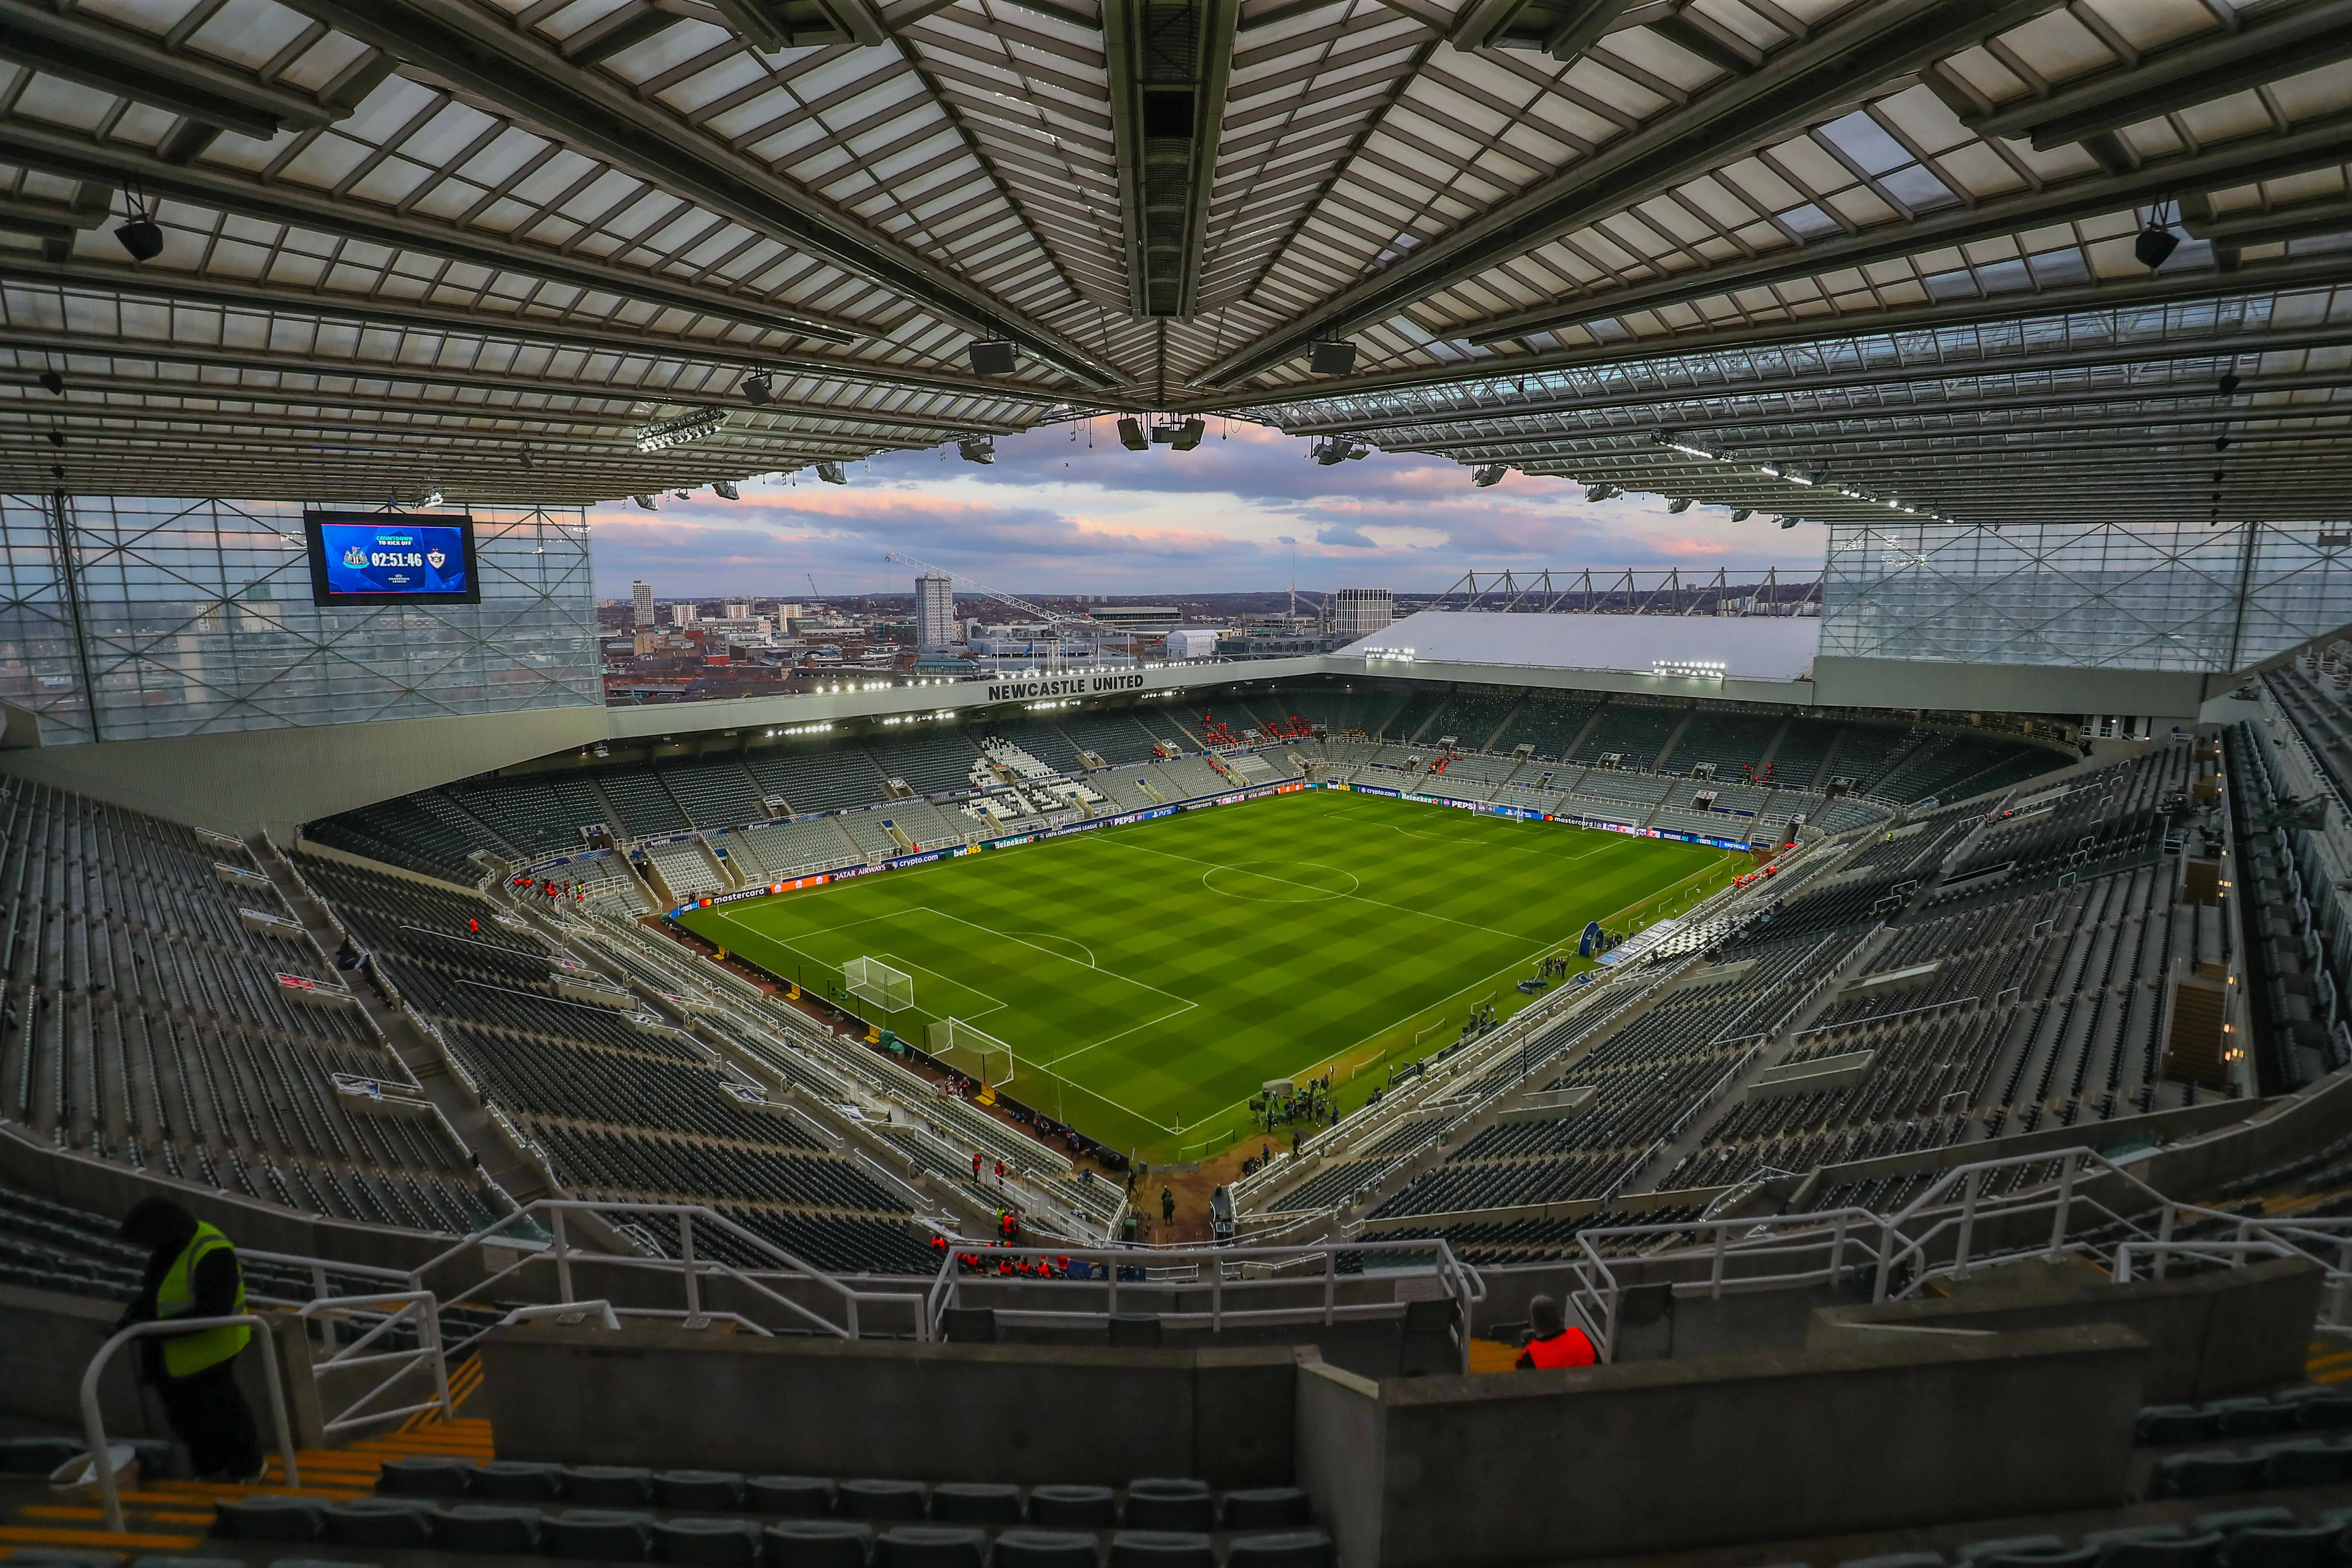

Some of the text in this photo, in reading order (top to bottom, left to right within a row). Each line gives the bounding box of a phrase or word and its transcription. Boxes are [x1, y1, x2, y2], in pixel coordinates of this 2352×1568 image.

[371, 552, 423, 567] 02:51:46
[989, 674, 1144, 701] NEWCASTLE UNITED
[1327, 783, 1351, 791] bet365
[1366, 788, 1396, 797] crypto.com
[1401, 793, 1432, 803] Heineken
[1187, 801, 1212, 810] mastercard
[1452, 800, 1476, 810] PEPSI
[1115, 815, 1135, 825] PEPSI
[1554, 817, 1592, 827] mastercard
[1057, 827, 1082, 836] CHAMPIONS
[1082, 823, 1097, 831] LEAGUE
[1606, 824, 1626, 833] FedEx
[995, 838, 1027, 849] Heineken
[953, 845, 982, 858] bet365
[534, 861, 556, 870] crypto.com
[900, 854, 938, 867] crypto.com
[833, 864, 886, 881] QATAR AIRWAYS
[714, 888, 764, 904] mastercard
